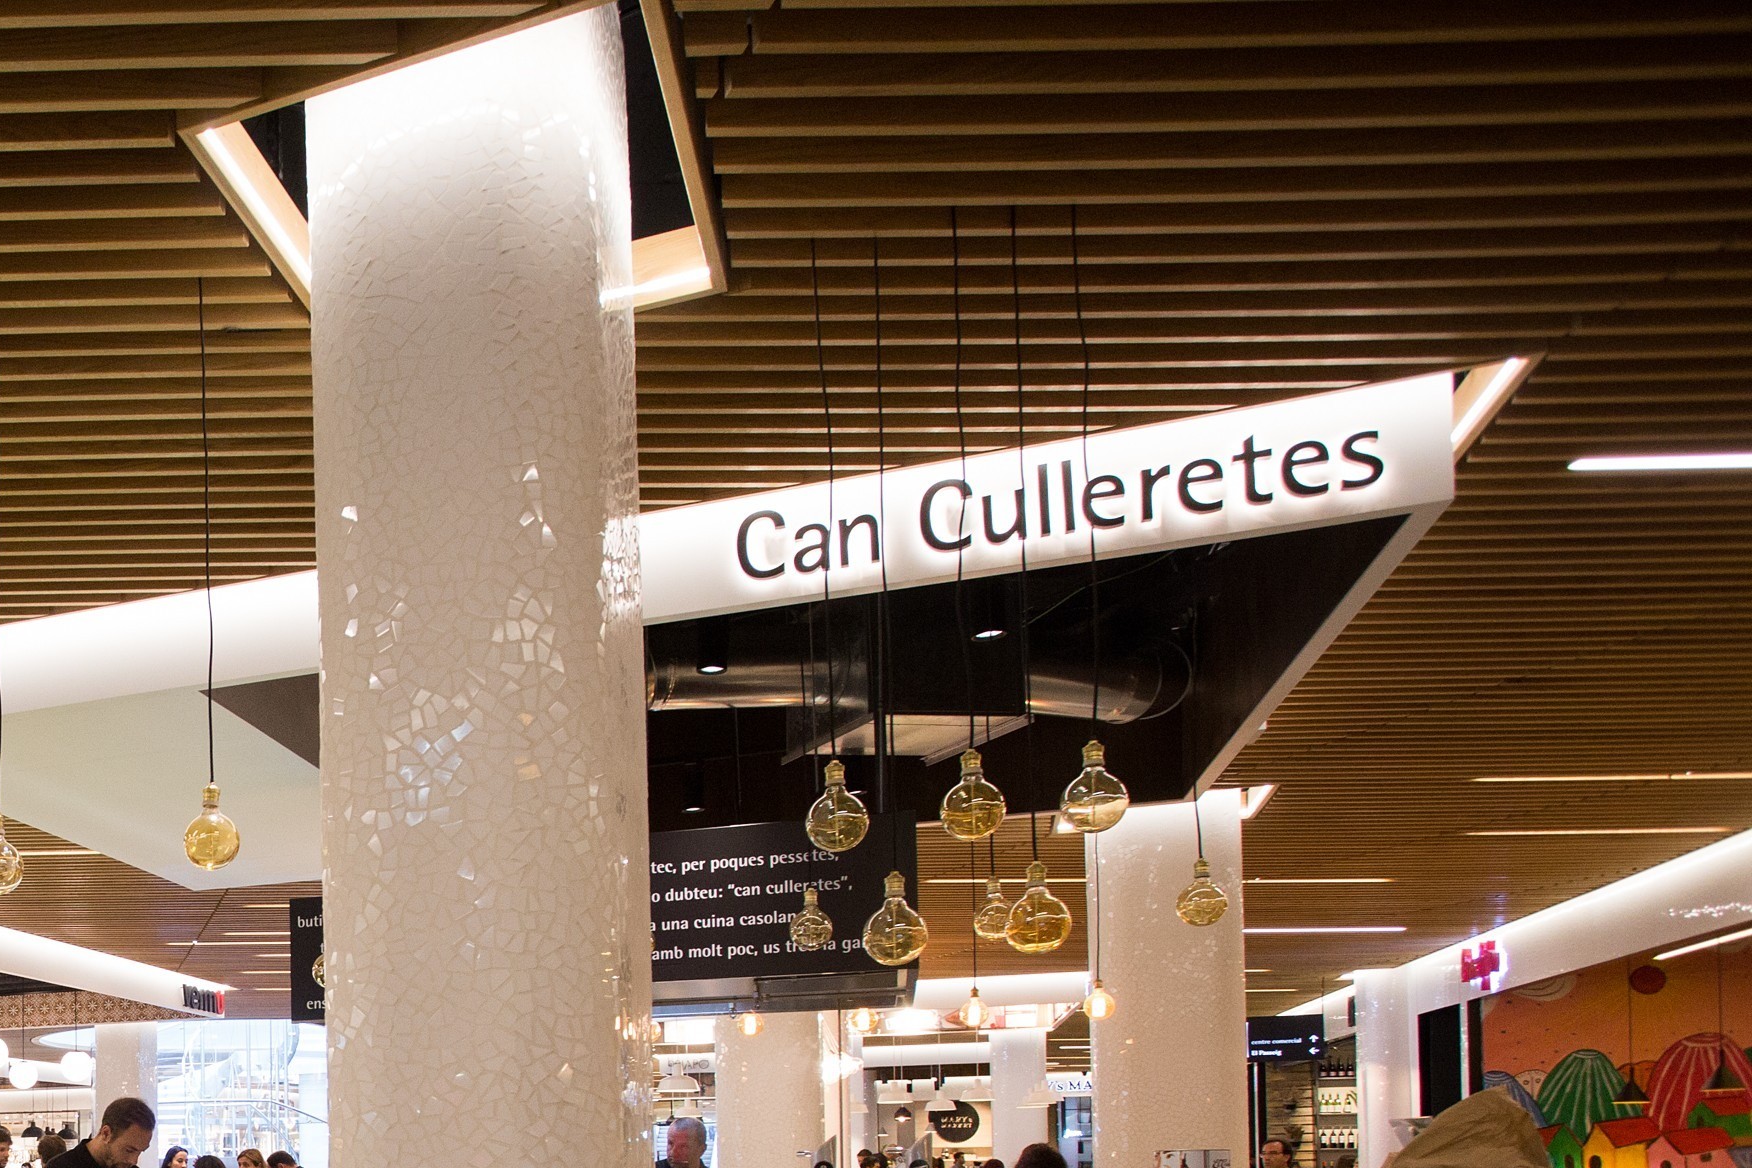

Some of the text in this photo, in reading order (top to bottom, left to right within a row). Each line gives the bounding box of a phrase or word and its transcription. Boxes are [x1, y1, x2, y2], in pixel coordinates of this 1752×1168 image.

[735, 430, 1385, 579] Can Culleretes
[681, 860, 706, 875] per
[710, 855, 765, 873] poques
[665, 887, 723, 902] dubteu:
[661, 919, 689, 931] una
[693, 914, 734, 929] cuina
[739, 911, 797, 926] casolan
[651, 945, 684, 960] amb
[688, 944, 723, 958] molt
[727, 944, 758, 960] poc,
[763, 942, 781, 954] us
